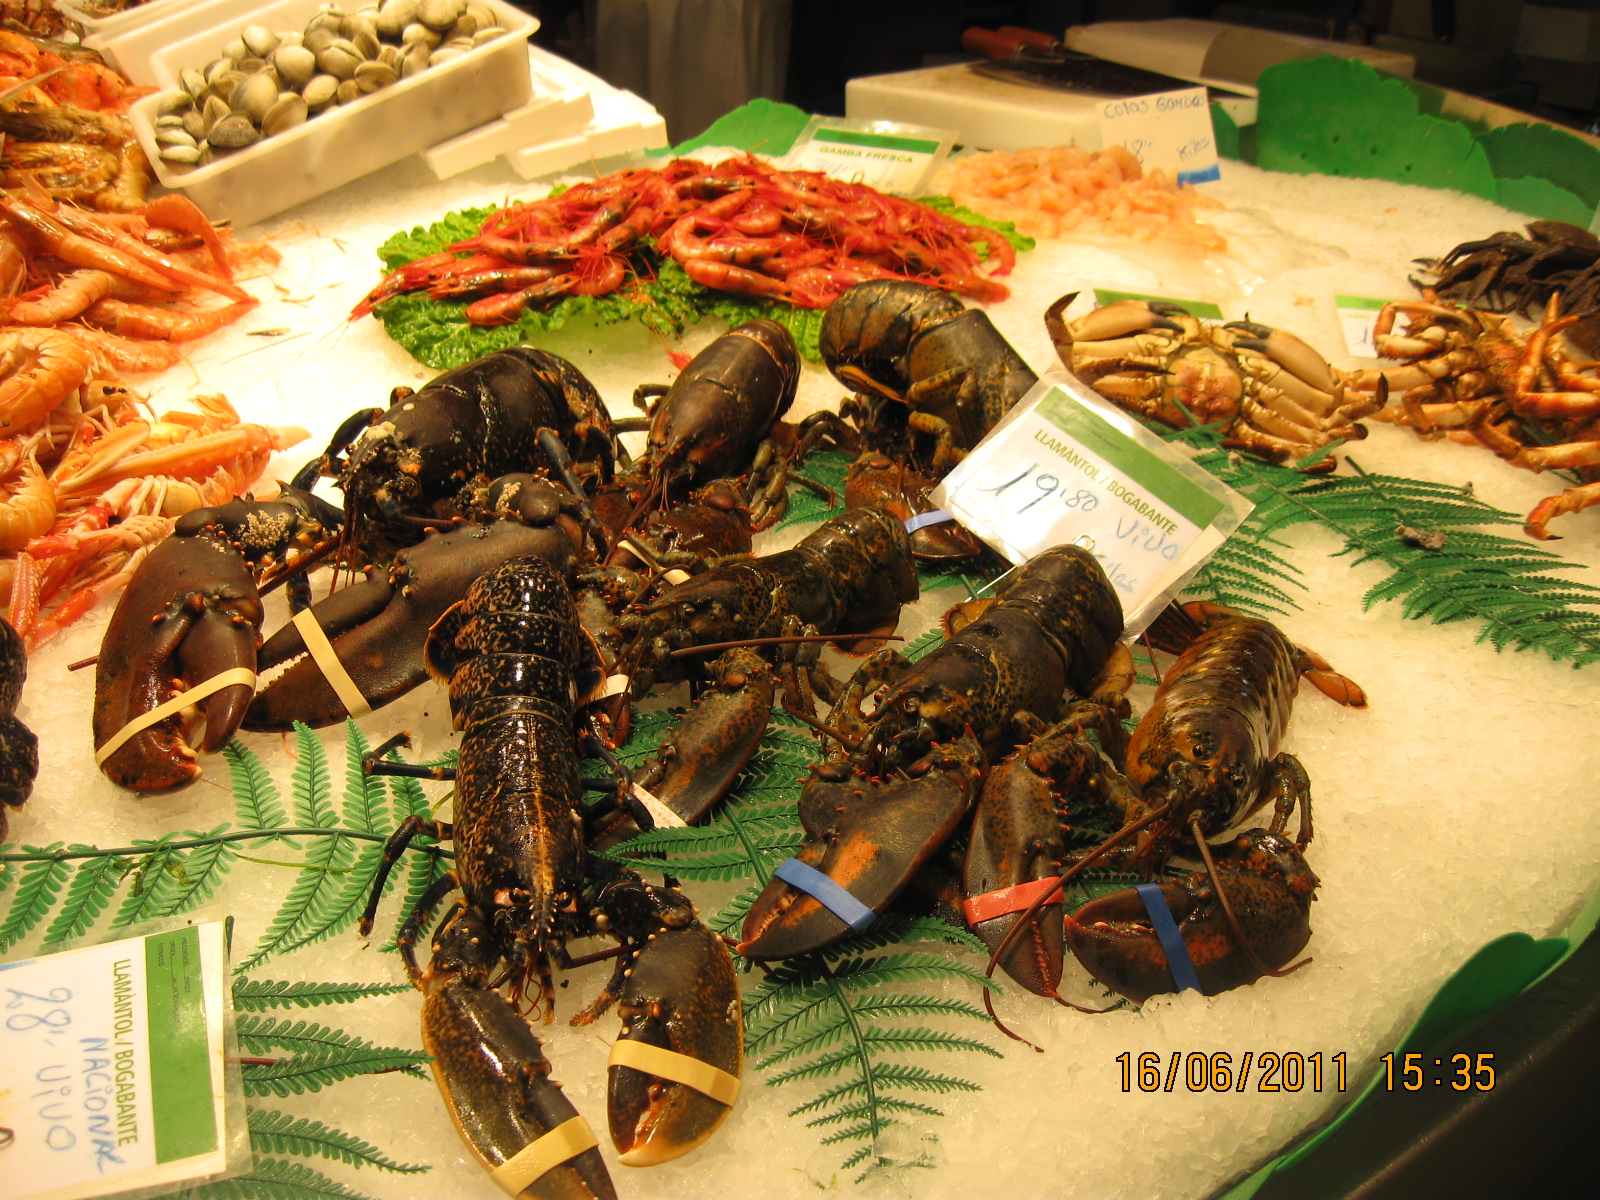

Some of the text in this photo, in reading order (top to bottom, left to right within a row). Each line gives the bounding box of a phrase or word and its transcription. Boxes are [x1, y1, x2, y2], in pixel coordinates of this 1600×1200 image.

[820, 147, 914, 164] GAMBA FRESCA
[1034, 429, 1101, 481] LLAMÀNTOL
[1106, 479, 1179, 536] BOGABANTE
[113, 958, 134, 1040] LLAMÀNTOL
[114, 1048, 138, 1148] BOGABANTE
